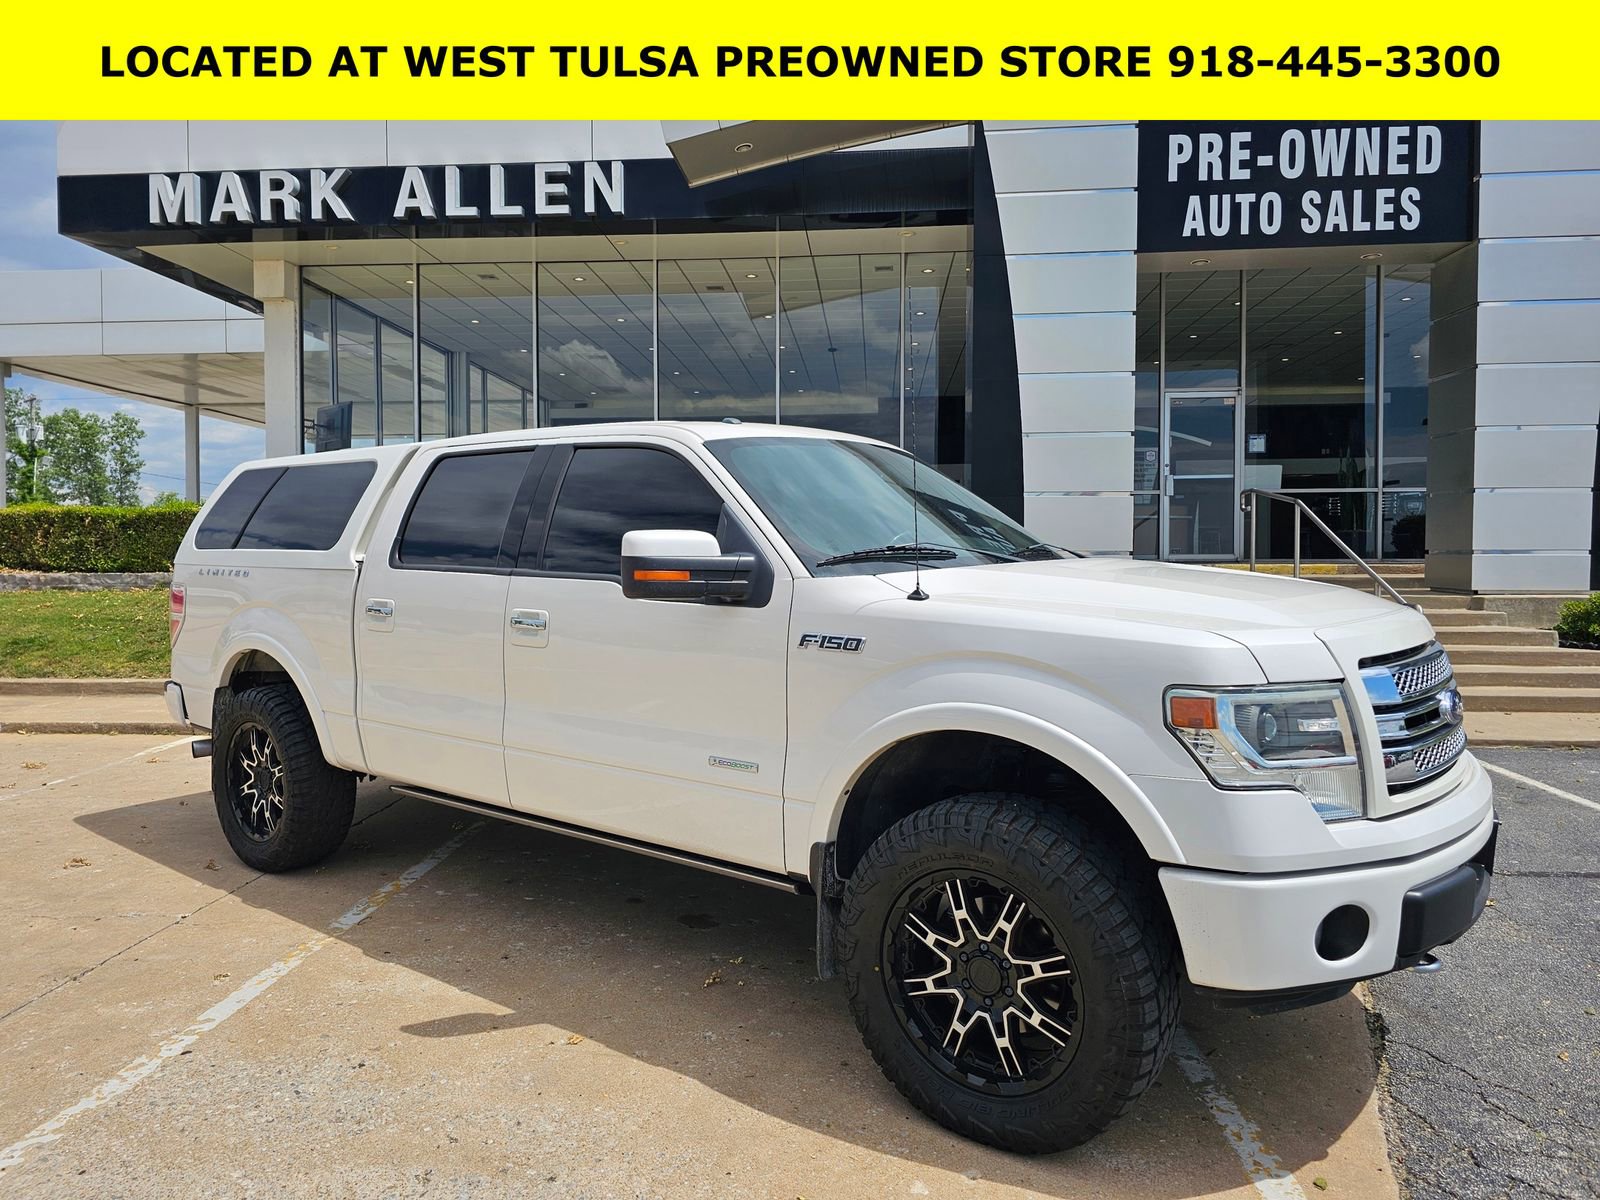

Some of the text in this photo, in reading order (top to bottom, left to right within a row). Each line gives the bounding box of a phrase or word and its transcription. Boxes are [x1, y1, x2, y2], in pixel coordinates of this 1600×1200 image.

[1168, 125, 1442, 182] PRE-OWNED
[149, 161, 625, 226] MARK ALLEN
[1182, 186, 1421, 237] AUTO SALES
[198, 568, 250, 578] LIMITED
[797, 632, 867, 653] F-150
